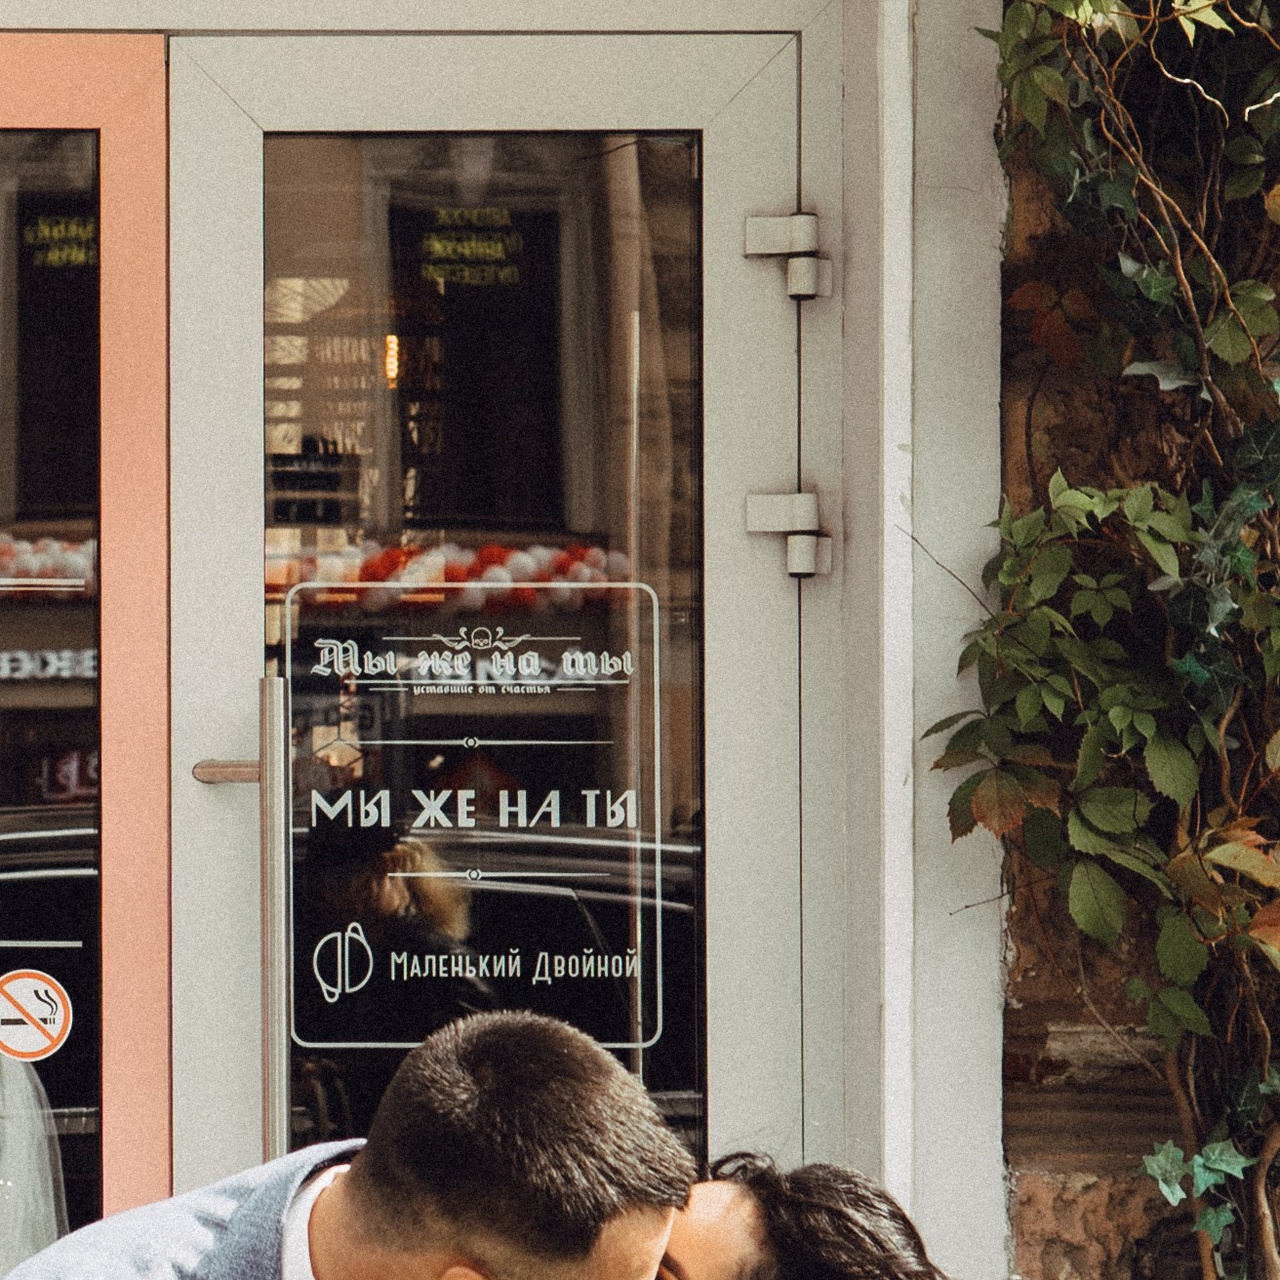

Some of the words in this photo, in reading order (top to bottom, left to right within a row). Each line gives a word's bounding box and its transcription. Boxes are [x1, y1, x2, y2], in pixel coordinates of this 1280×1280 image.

[310, 638, 398, 677] Мы
[417, 650, 472, 676] же
[492, 650, 543, 676] на
[562, 650, 635, 676] ты
[413, 685, 474, 696] уставшие
[478, 685, 496, 694] от
[501, 684, 551, 695] счастья
[311, 789, 391, 828] МЫ
[411, 789, 476, 828] ЖЕ
[499, 789, 560, 828] НА
[581, 789, 638, 828] ТЫ
